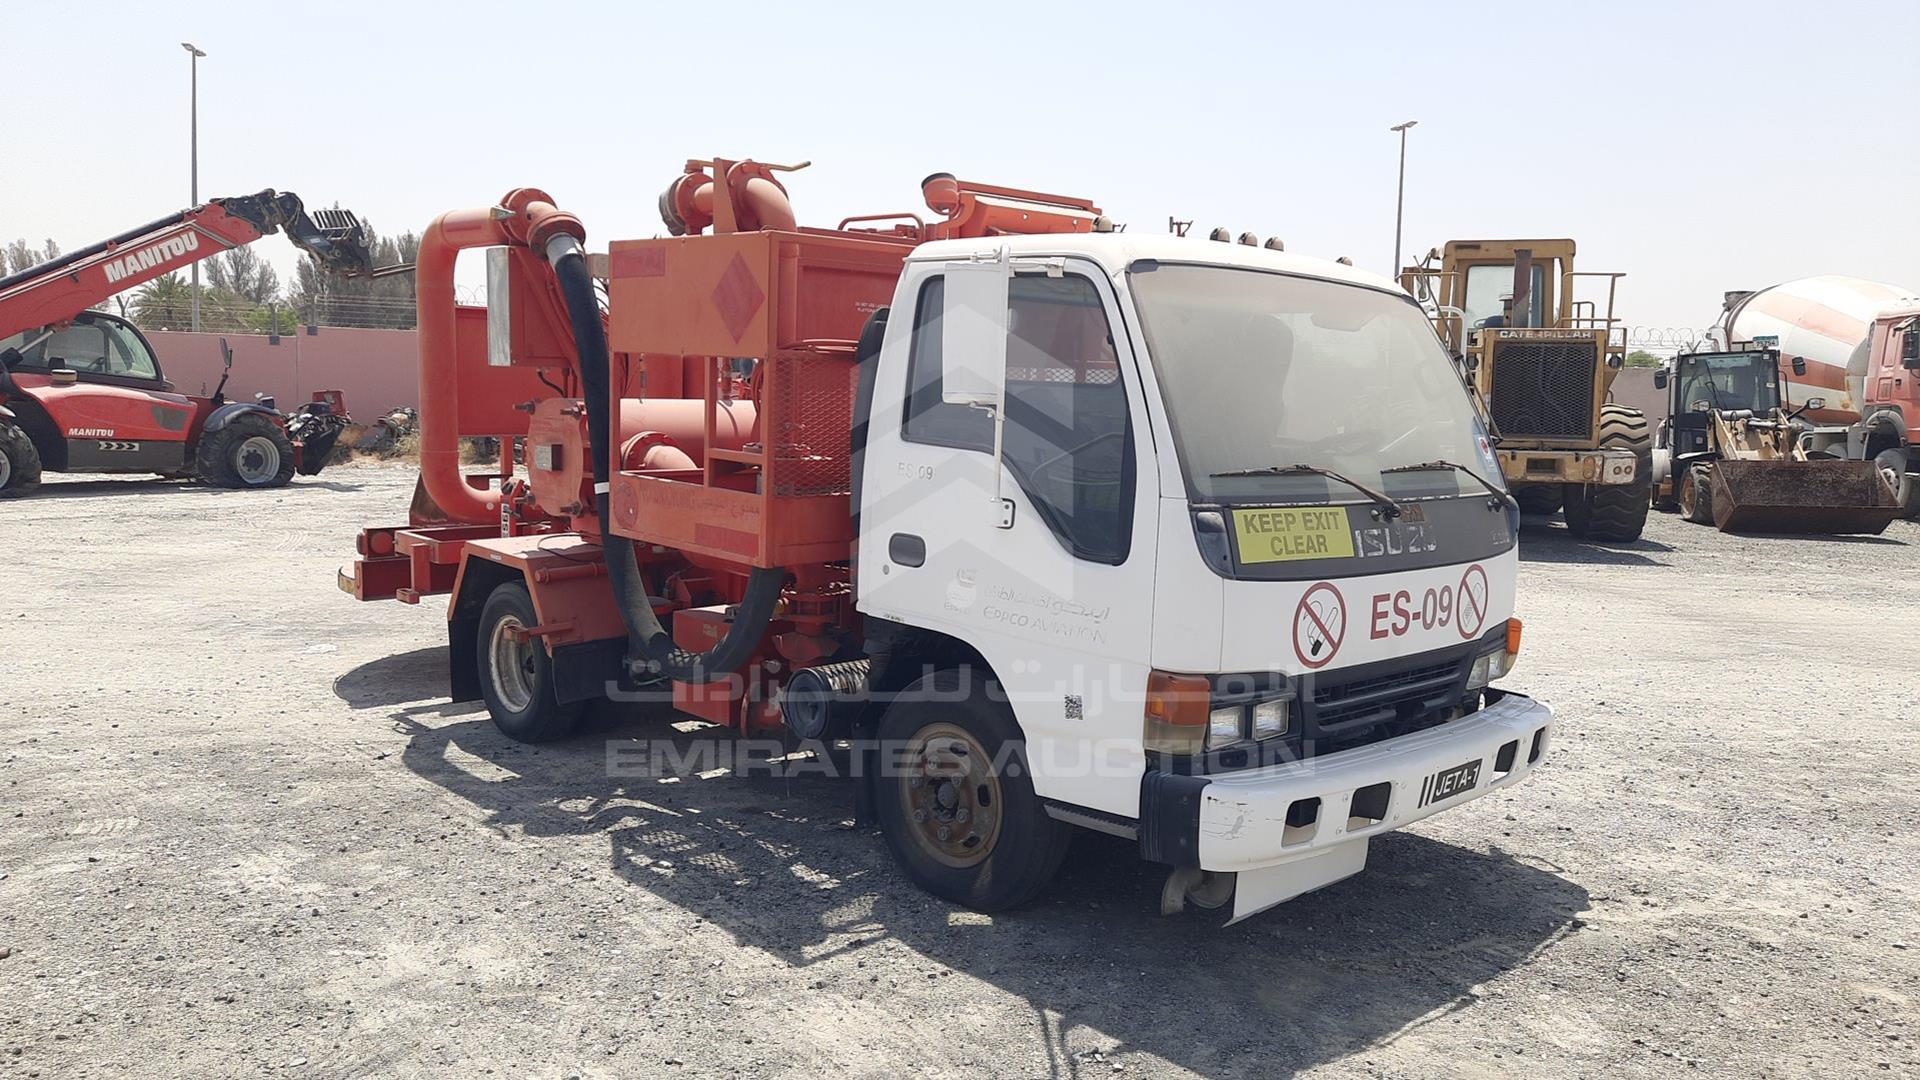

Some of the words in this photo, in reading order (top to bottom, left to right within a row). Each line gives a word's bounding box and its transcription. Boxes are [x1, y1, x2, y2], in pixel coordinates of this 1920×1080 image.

[104, 230, 199, 283] MANITOU
[1500, 330, 1592, 339] CATERPILLAR
[68, 428, 115, 437] MANITOU
[1242, 511, 1296, 534] KEEP
[1303, 510, 1341, 531] EXIT
[1270, 534, 1329, 556] CLEAR
[1370, 585, 1453, 640] ES-09
[1435, 765, 1480, 796] JETA-1
